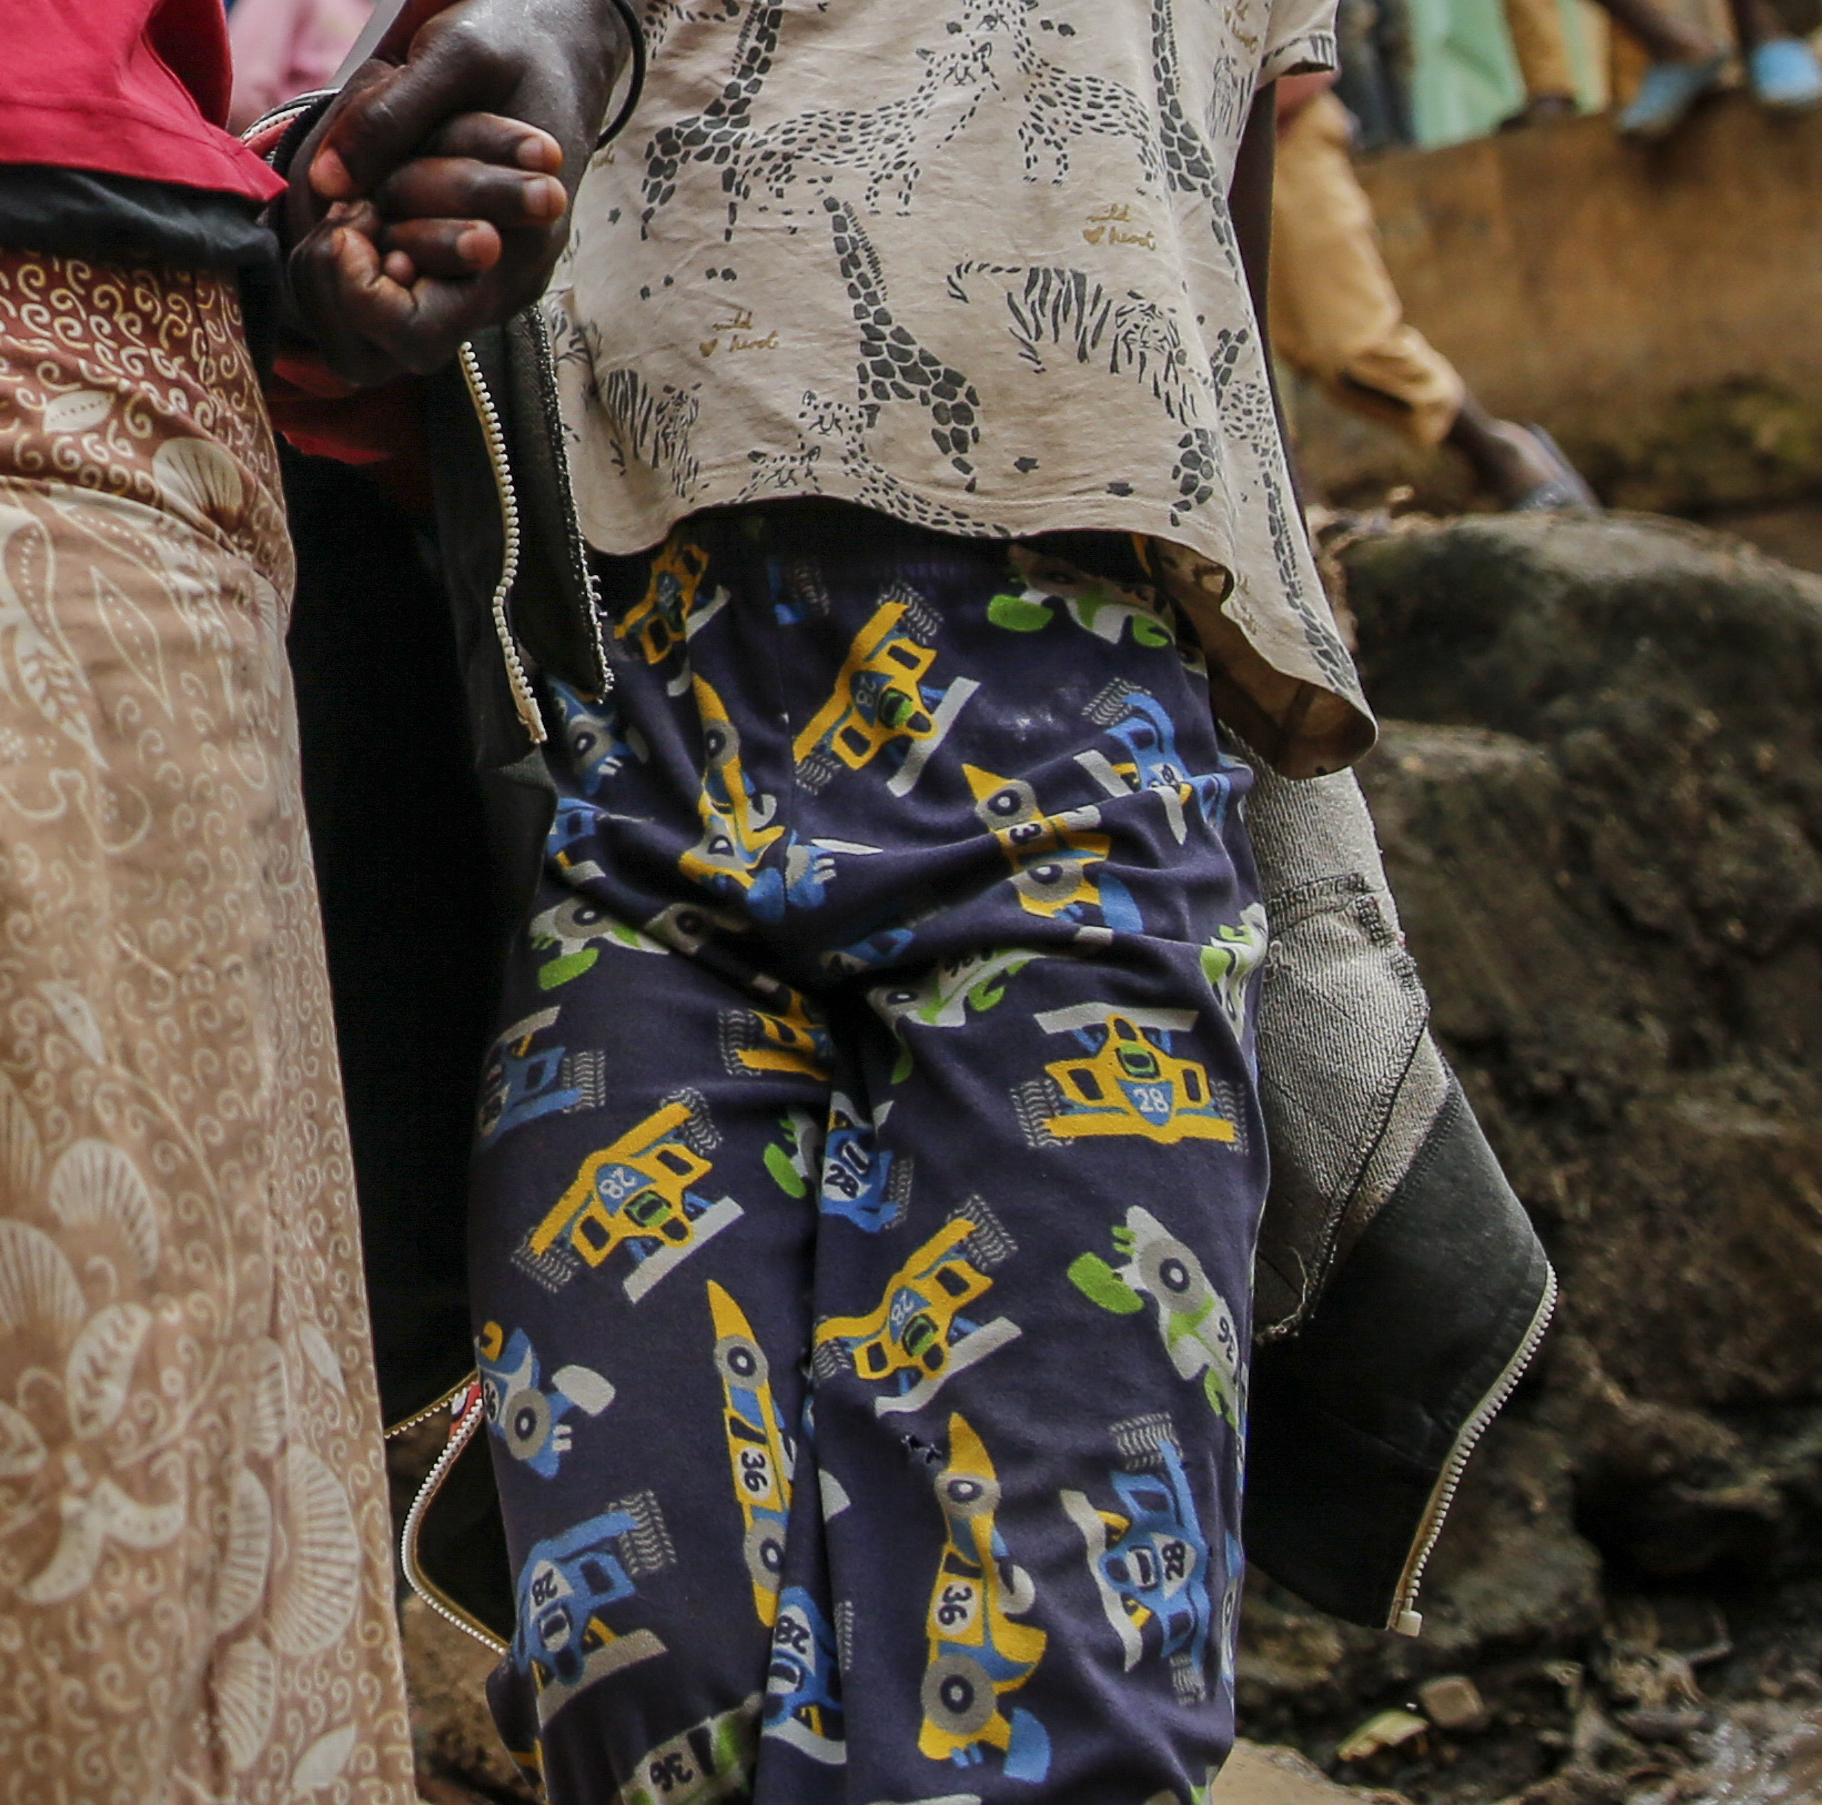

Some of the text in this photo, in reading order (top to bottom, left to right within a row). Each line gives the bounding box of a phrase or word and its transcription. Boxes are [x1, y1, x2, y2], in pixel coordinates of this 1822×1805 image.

[1132, 1088, 1170, 1113] 28
[598, 1165, 637, 1200] 28
[824, 1162, 860, 1200] 28
[890, 1290, 915, 1327] 28
[739, 1451, 769, 1493] 36
[1161, 1540, 1187, 1581] 28
[531, 1567, 558, 1607] 28
[937, 1584, 973, 1626] 36
[775, 1614, 811, 1655] 28
[648, 1752, 694, 1793] 36
